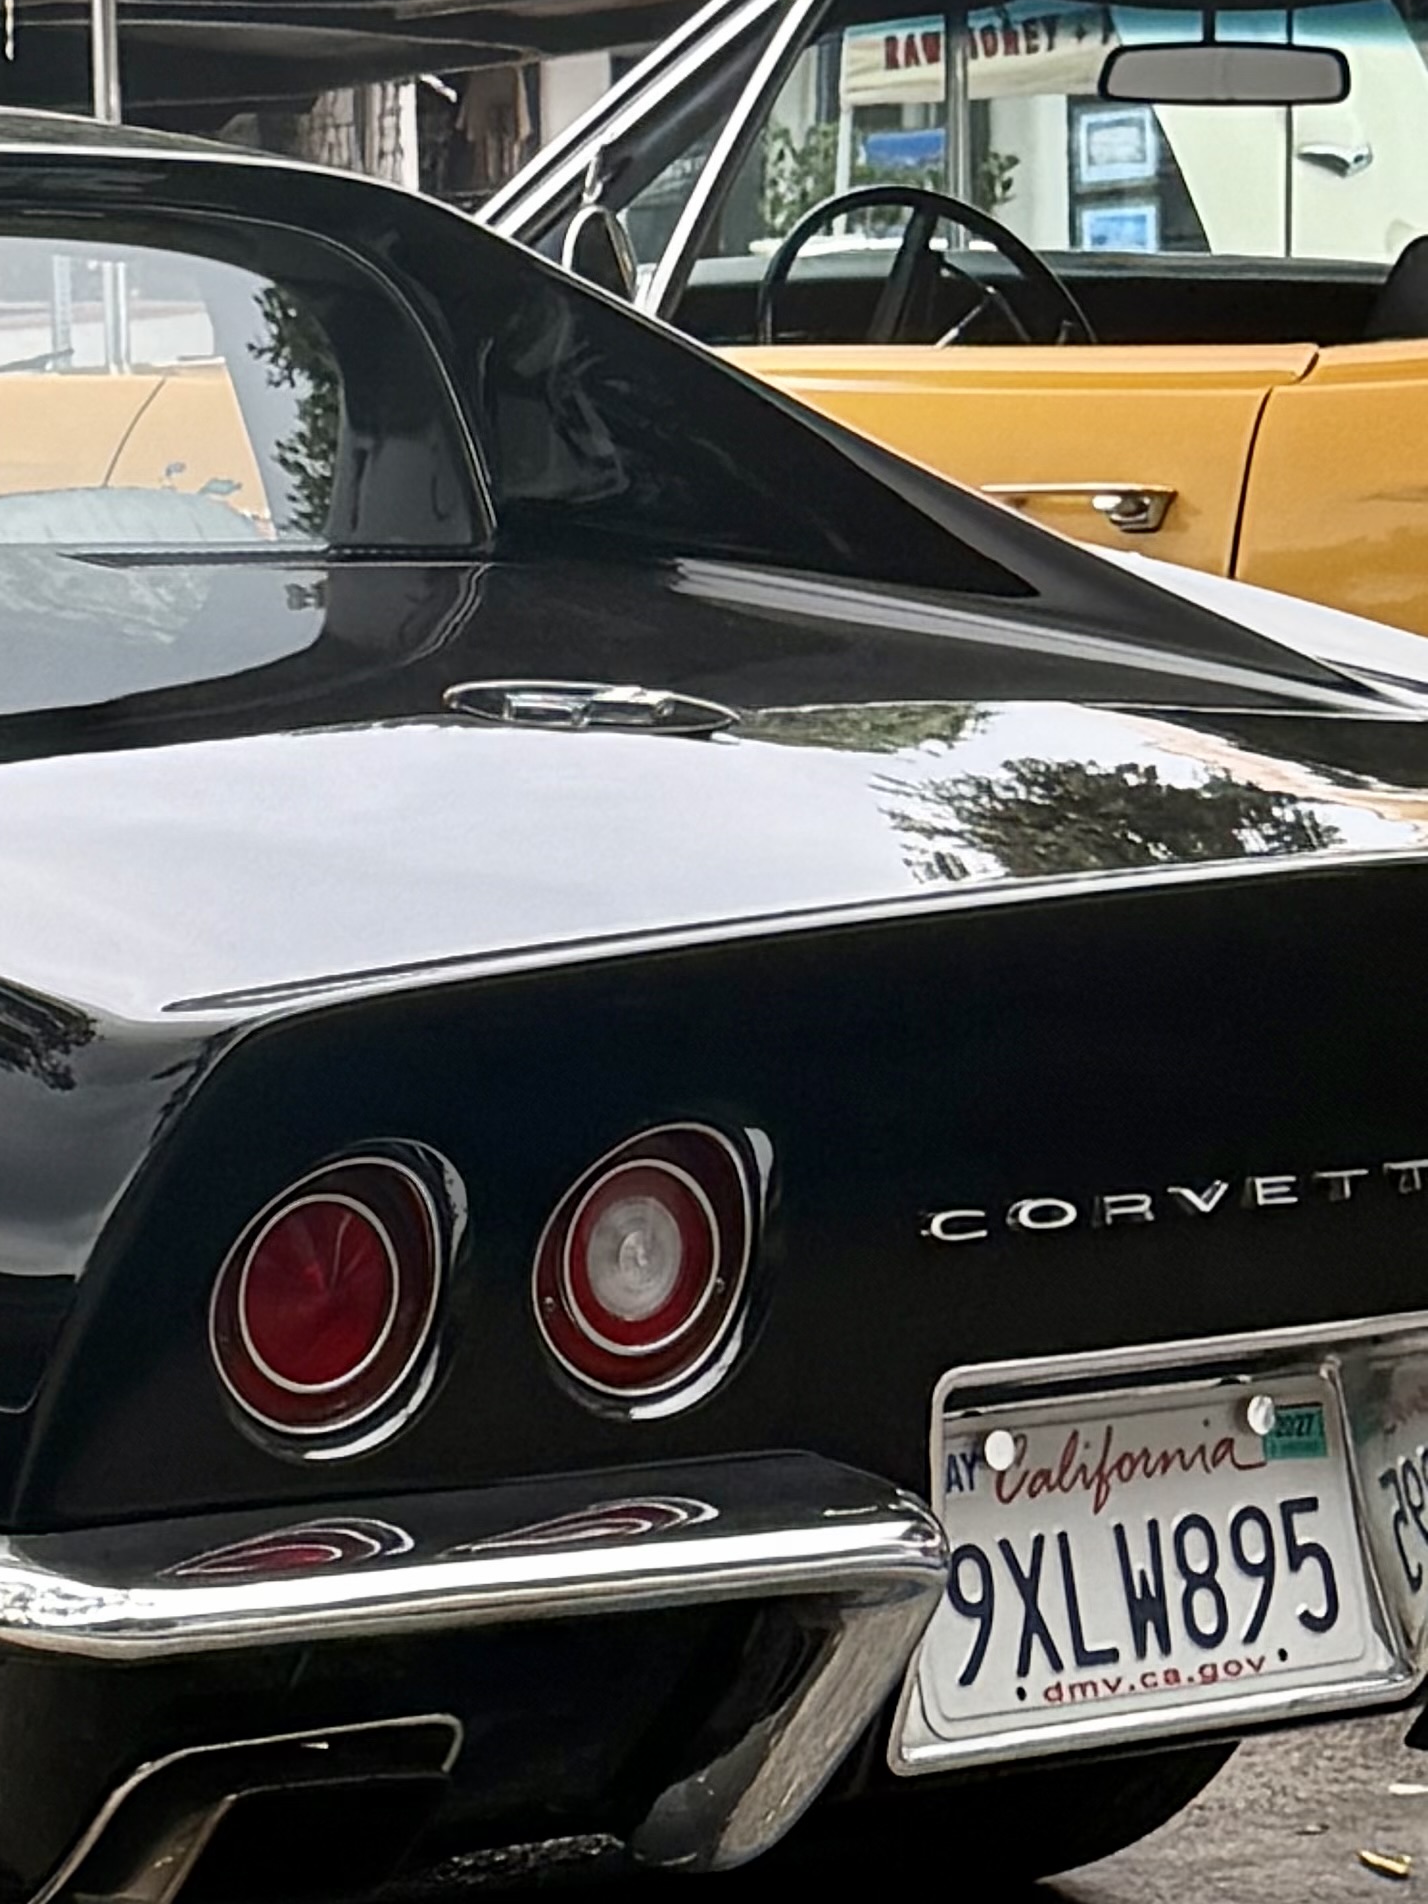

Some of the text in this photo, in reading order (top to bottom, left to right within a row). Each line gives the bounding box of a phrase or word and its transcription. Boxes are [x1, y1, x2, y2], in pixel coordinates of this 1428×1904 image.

[885, 31, 941, 70] RAW
[922, 1159, 1428, 1242] CORVETT
[946, 1425, 1267, 1516] AY California
[947, 1496, 1340, 1688] 9XLW895
[1043, 1654, 1267, 1704] dmv.ca.gov
